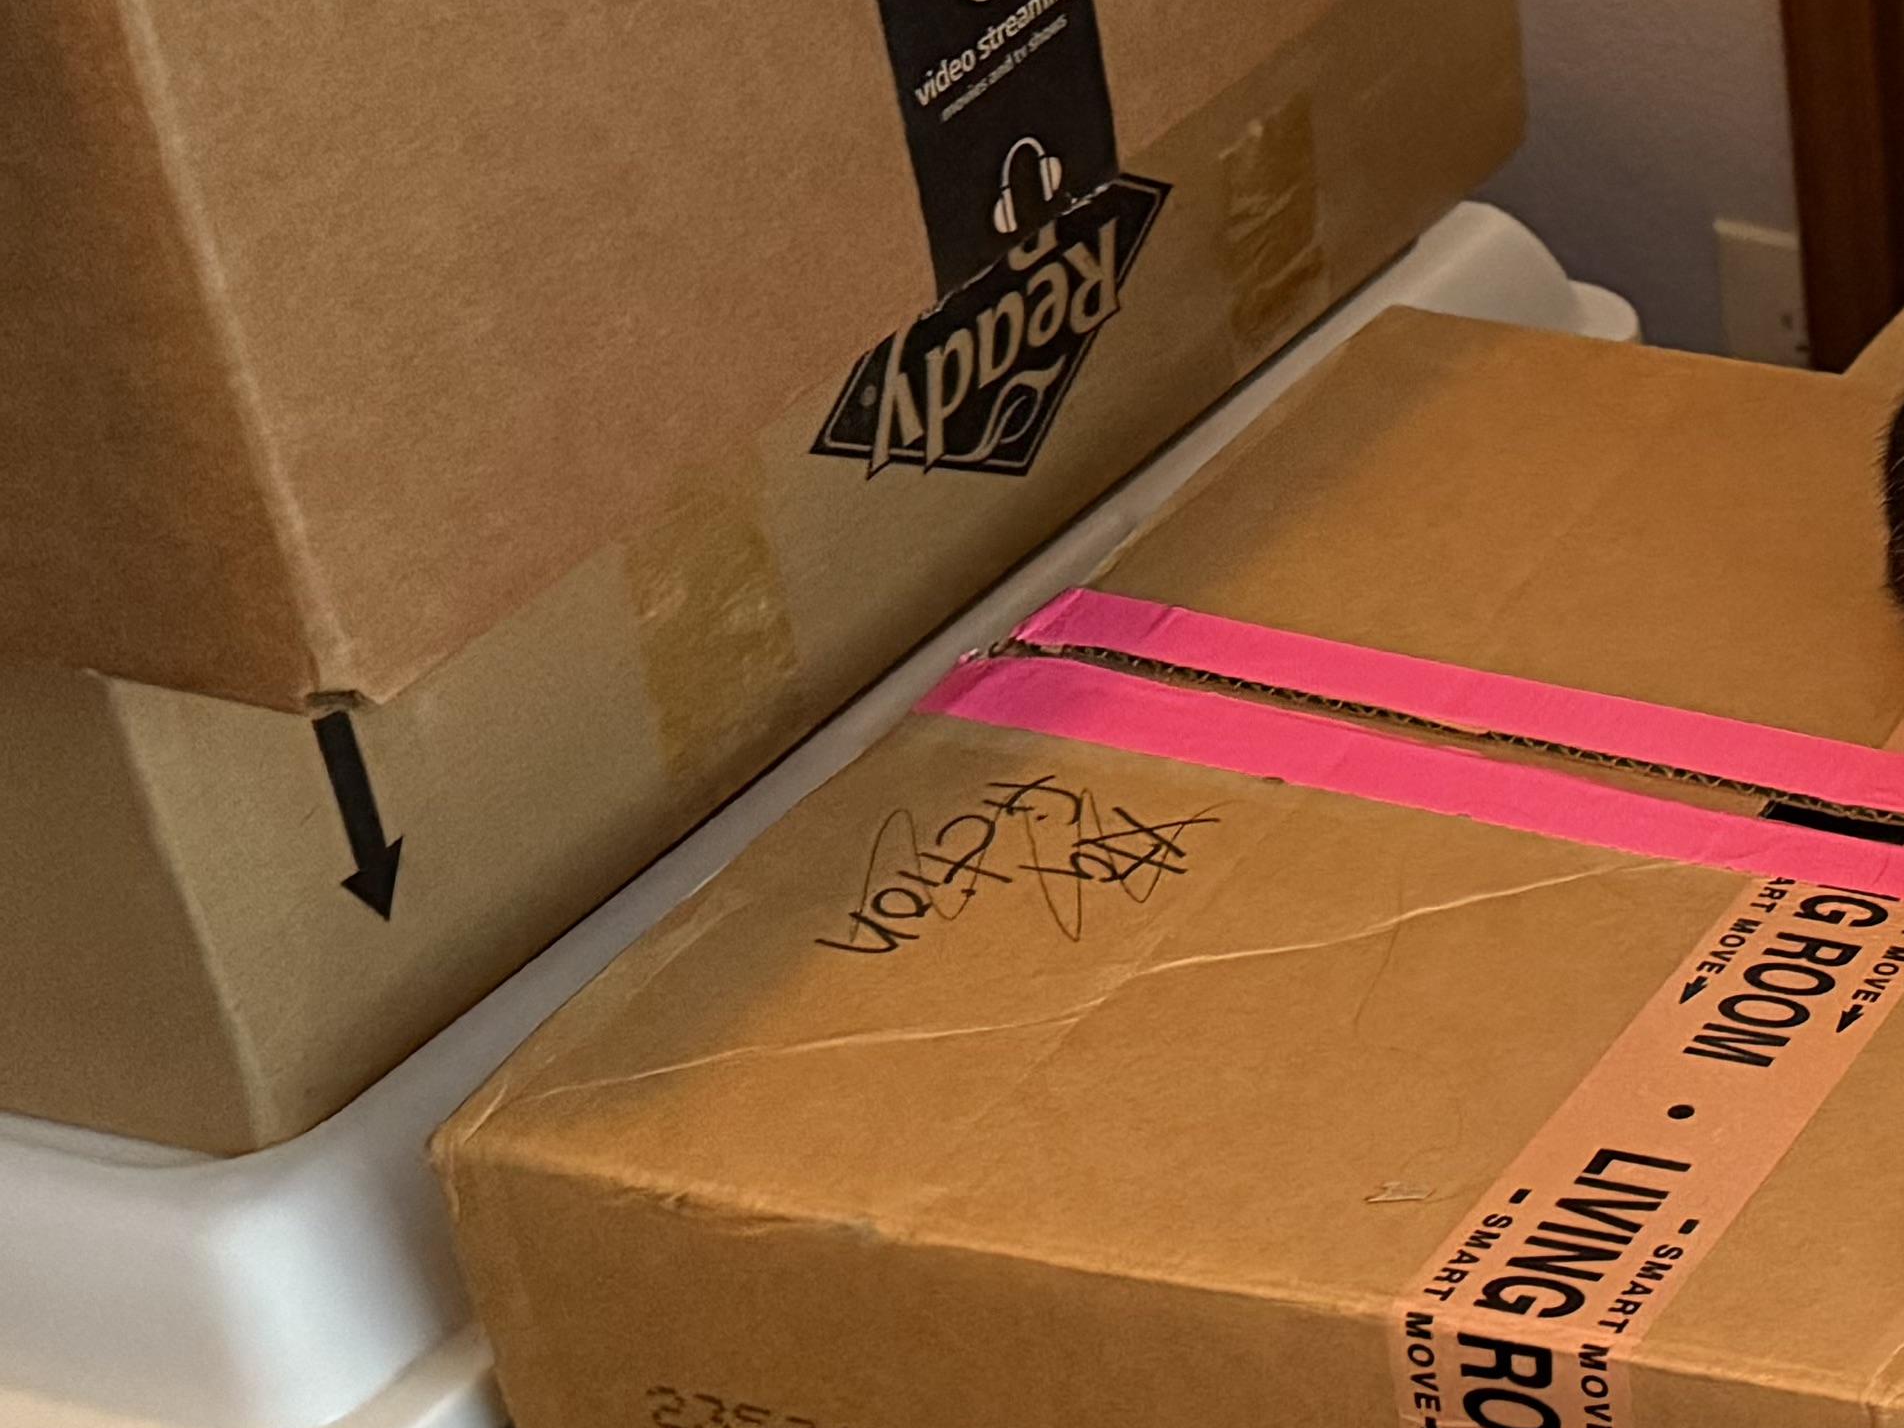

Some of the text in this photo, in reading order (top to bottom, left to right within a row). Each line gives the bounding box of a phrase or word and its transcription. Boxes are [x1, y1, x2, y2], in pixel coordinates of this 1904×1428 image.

[914, 46, 976, 108] video
[868, 219, 1123, 481] Ready
[1682, 884, 1901, 1068] G ROOM
[1695, 918, 1763, 975] MOVE
[1404, 1211, 1513, 1414] SMART MOVE
[1472, 1147, 1693, 1319] LIVING
[1597, 1243, 1684, 1334] SMART
